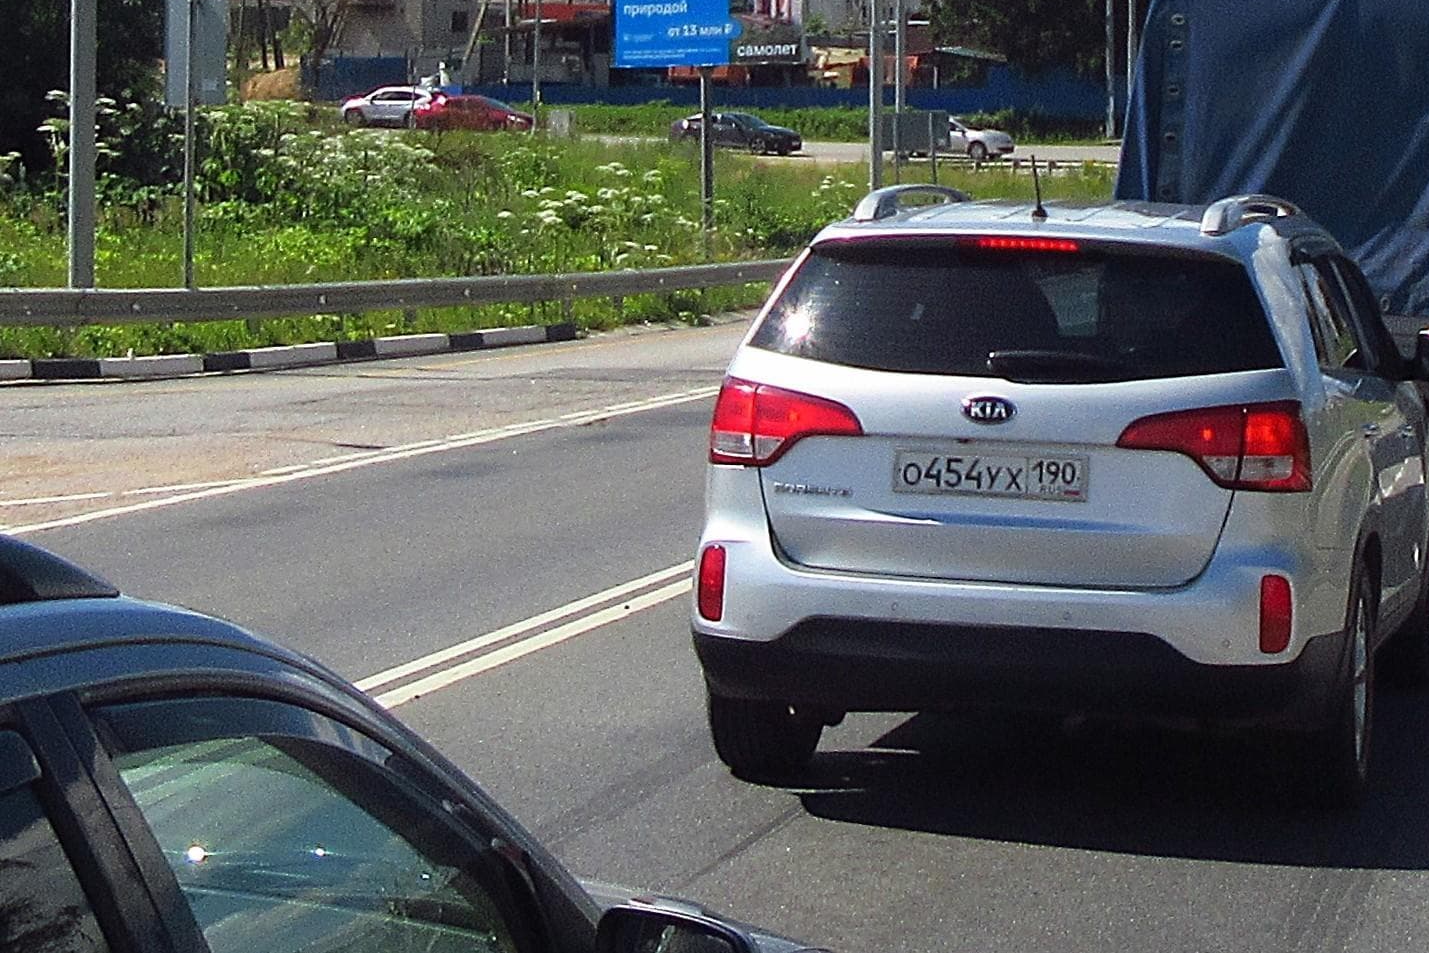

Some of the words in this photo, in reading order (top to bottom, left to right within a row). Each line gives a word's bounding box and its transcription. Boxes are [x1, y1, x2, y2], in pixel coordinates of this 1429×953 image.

[623, 0, 688, 18] природой
[737, 43, 798, 57] самолет
[970, 399, 1008, 419] KIA
[1031, 460, 1077, 486] 190
